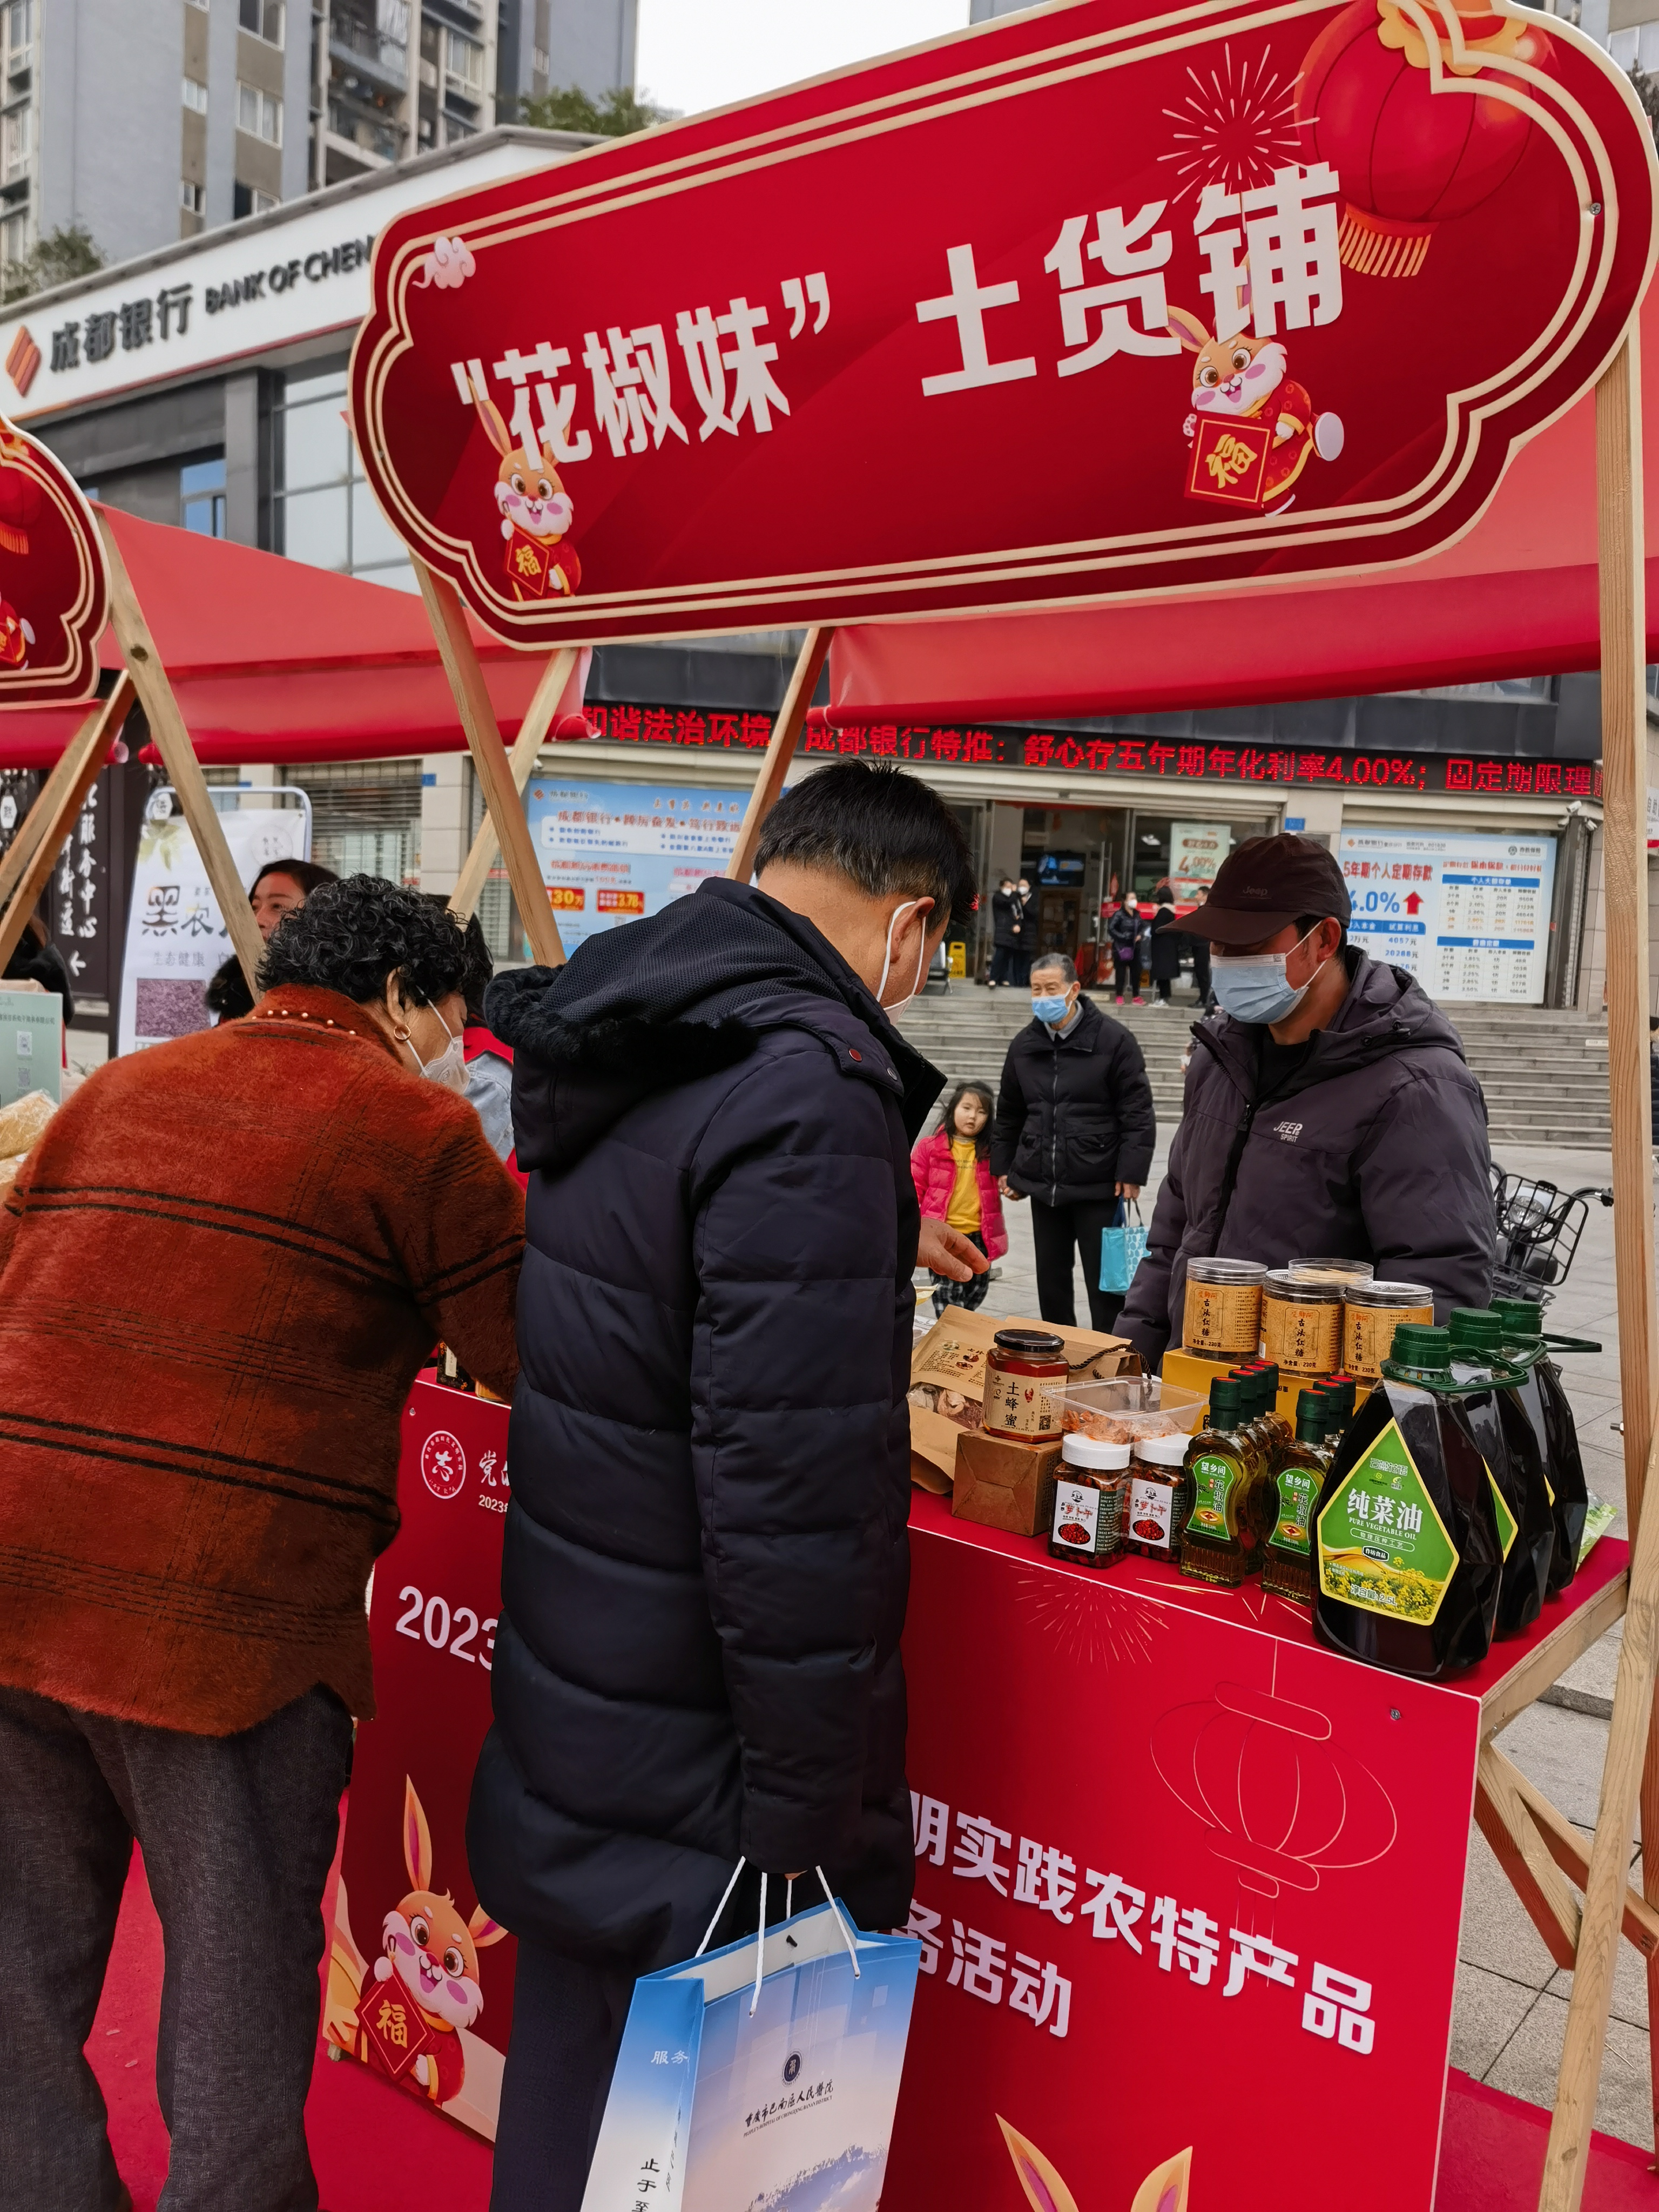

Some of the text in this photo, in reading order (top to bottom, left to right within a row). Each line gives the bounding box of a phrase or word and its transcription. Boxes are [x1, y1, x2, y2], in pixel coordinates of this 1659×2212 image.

[205, 270, 266, 314] BANK
[269, 259, 301, 293] OF
[915, 161, 1343, 397] 土货铺
[50, 283, 193, 372] 成都银行
[1205, 434, 1258, 489] 福
[515, 544, 542, 577] 福
[1343, 861, 1433, 881] 5年期个人定期存款
[1243, 886, 1268, 898] Jeep
[1273, 1121, 1303, 1136] JEEP
[1280, 1133, 1298, 1143] SPIRIT
[1202, 1298, 1211, 1337] 古法红糖
[1294, 1318, 1305, 1358] 古法红糖
[1354, 1321, 1363, 1363] 古法红糖
[1004, 1381, 1020, 1427] 土蜂蜜
[1201, 1461, 1226, 1476] 望乡间
[1285, 1473, 1311, 1489] 望乡间
[1213, 1479, 1225, 1513] 花椒油
[1296, 1493, 1309, 1527] 花椒油
[1347, 1488, 1424, 1533] 纯菜油
[1349, 1516, 1417, 1540] PURE VEGETABLE OIL
[1360, 1532, 1404, 1548] 物理压榨工艺
[396, 1586, 498, 1671] 2023
[909, 1790, 1375, 2055] 明实践农特产品
[376, 1999, 408, 2048] 福
[651, 2050, 688, 2065] 服务
